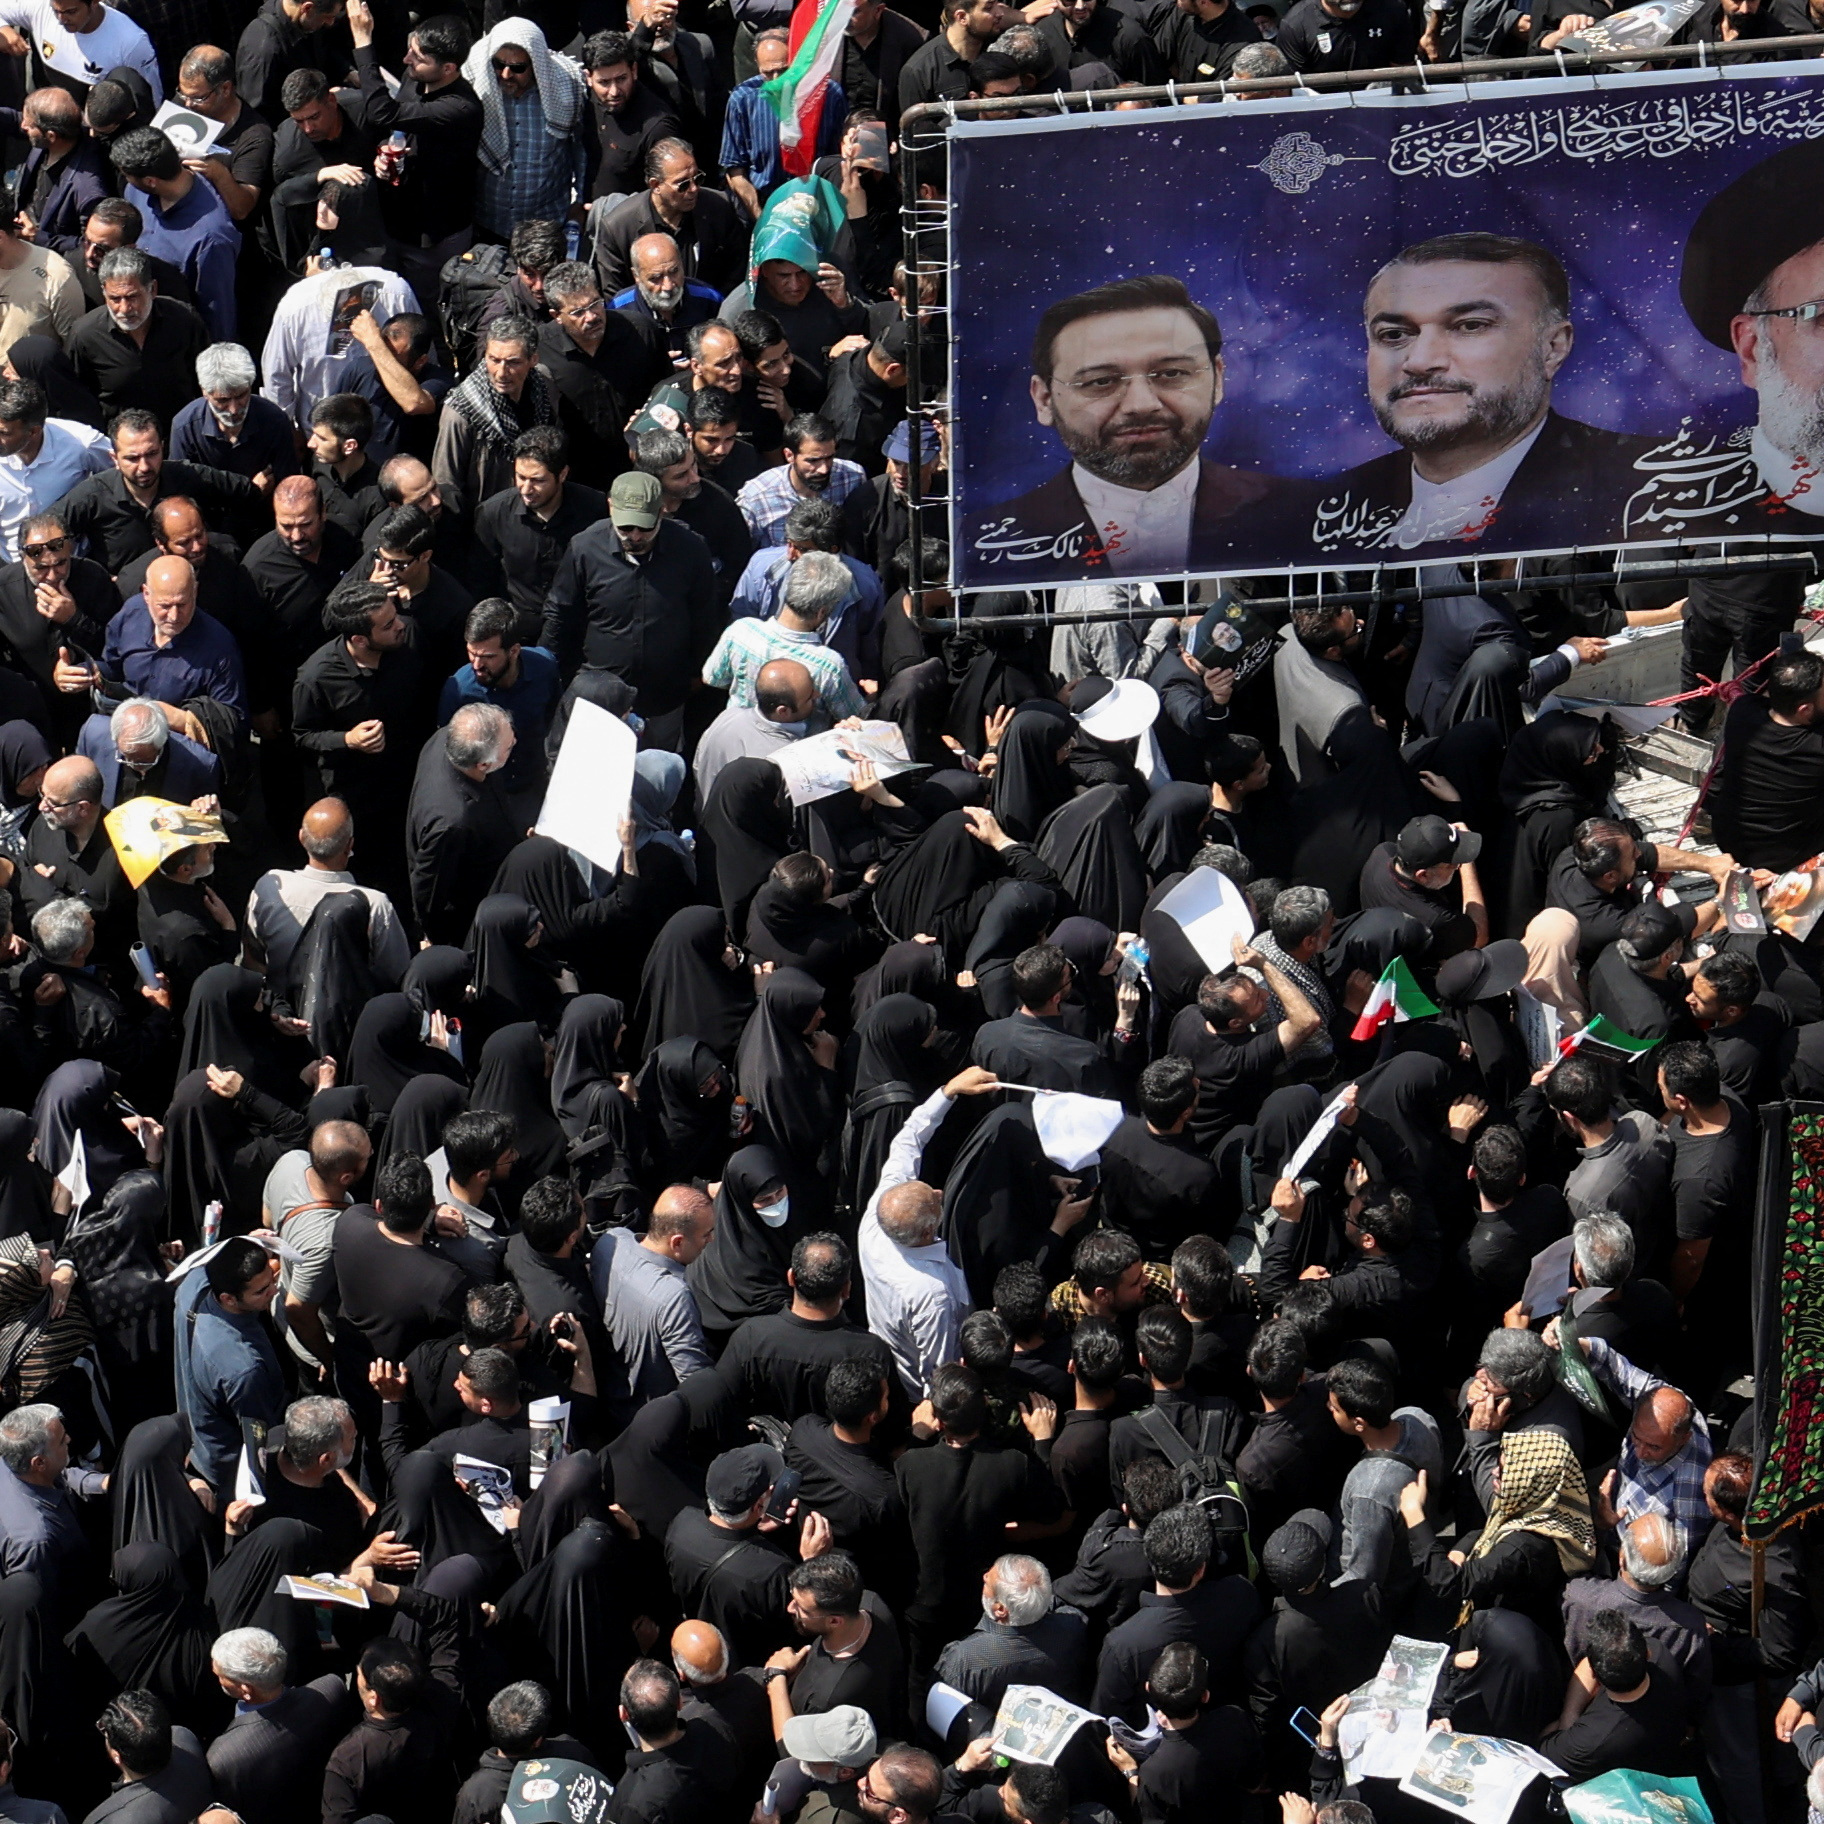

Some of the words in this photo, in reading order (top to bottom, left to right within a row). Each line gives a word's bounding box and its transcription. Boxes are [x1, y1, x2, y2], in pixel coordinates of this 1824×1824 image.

[1755, 455, 1821, 514] شهید
[1007, 520, 1086, 562] مالک
[1454, 495, 1504, 543] شهید
[1081, 520, 1132, 567] شهید
